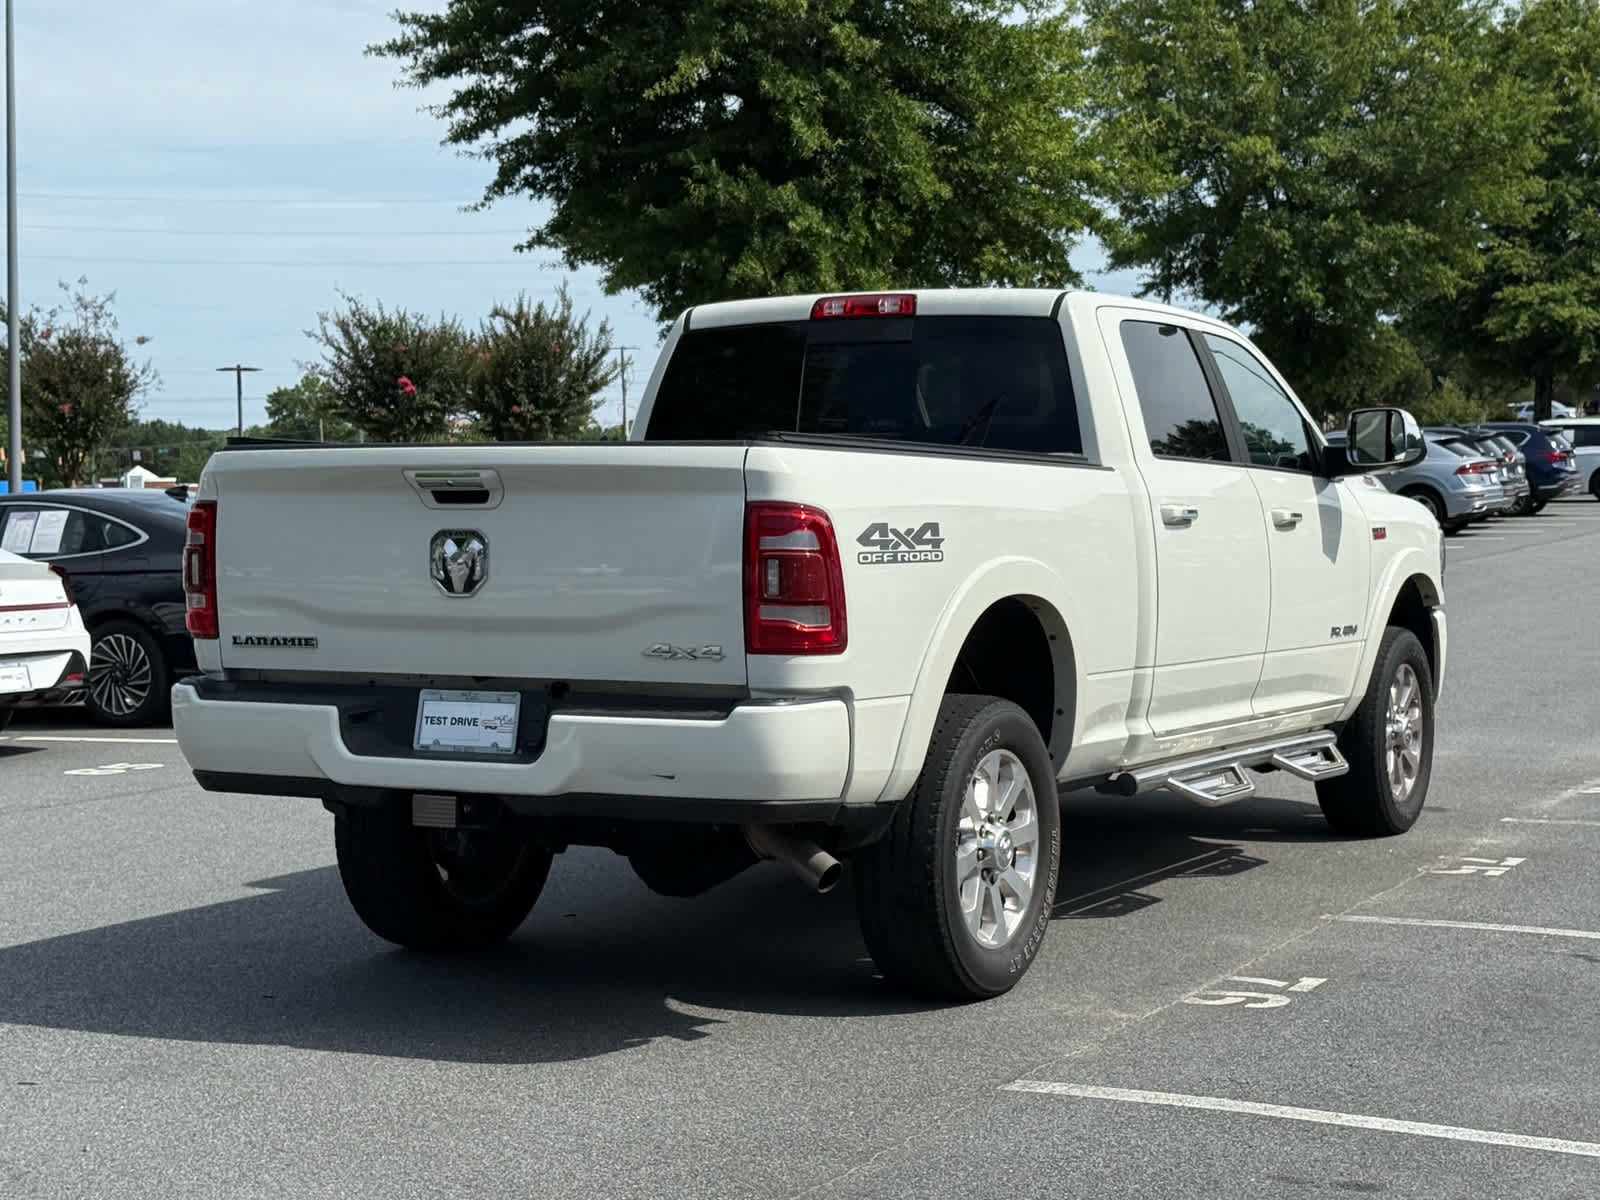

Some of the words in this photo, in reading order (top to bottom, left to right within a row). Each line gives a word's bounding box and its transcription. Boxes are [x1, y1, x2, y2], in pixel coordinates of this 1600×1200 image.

[859, 552, 894, 563] OFF
[897, 551, 943, 562] ROAD
[231, 635, 318, 648] LARAMIE
[424, 716, 448, 725] TEST
[450, 717, 479, 727] DRIVE
